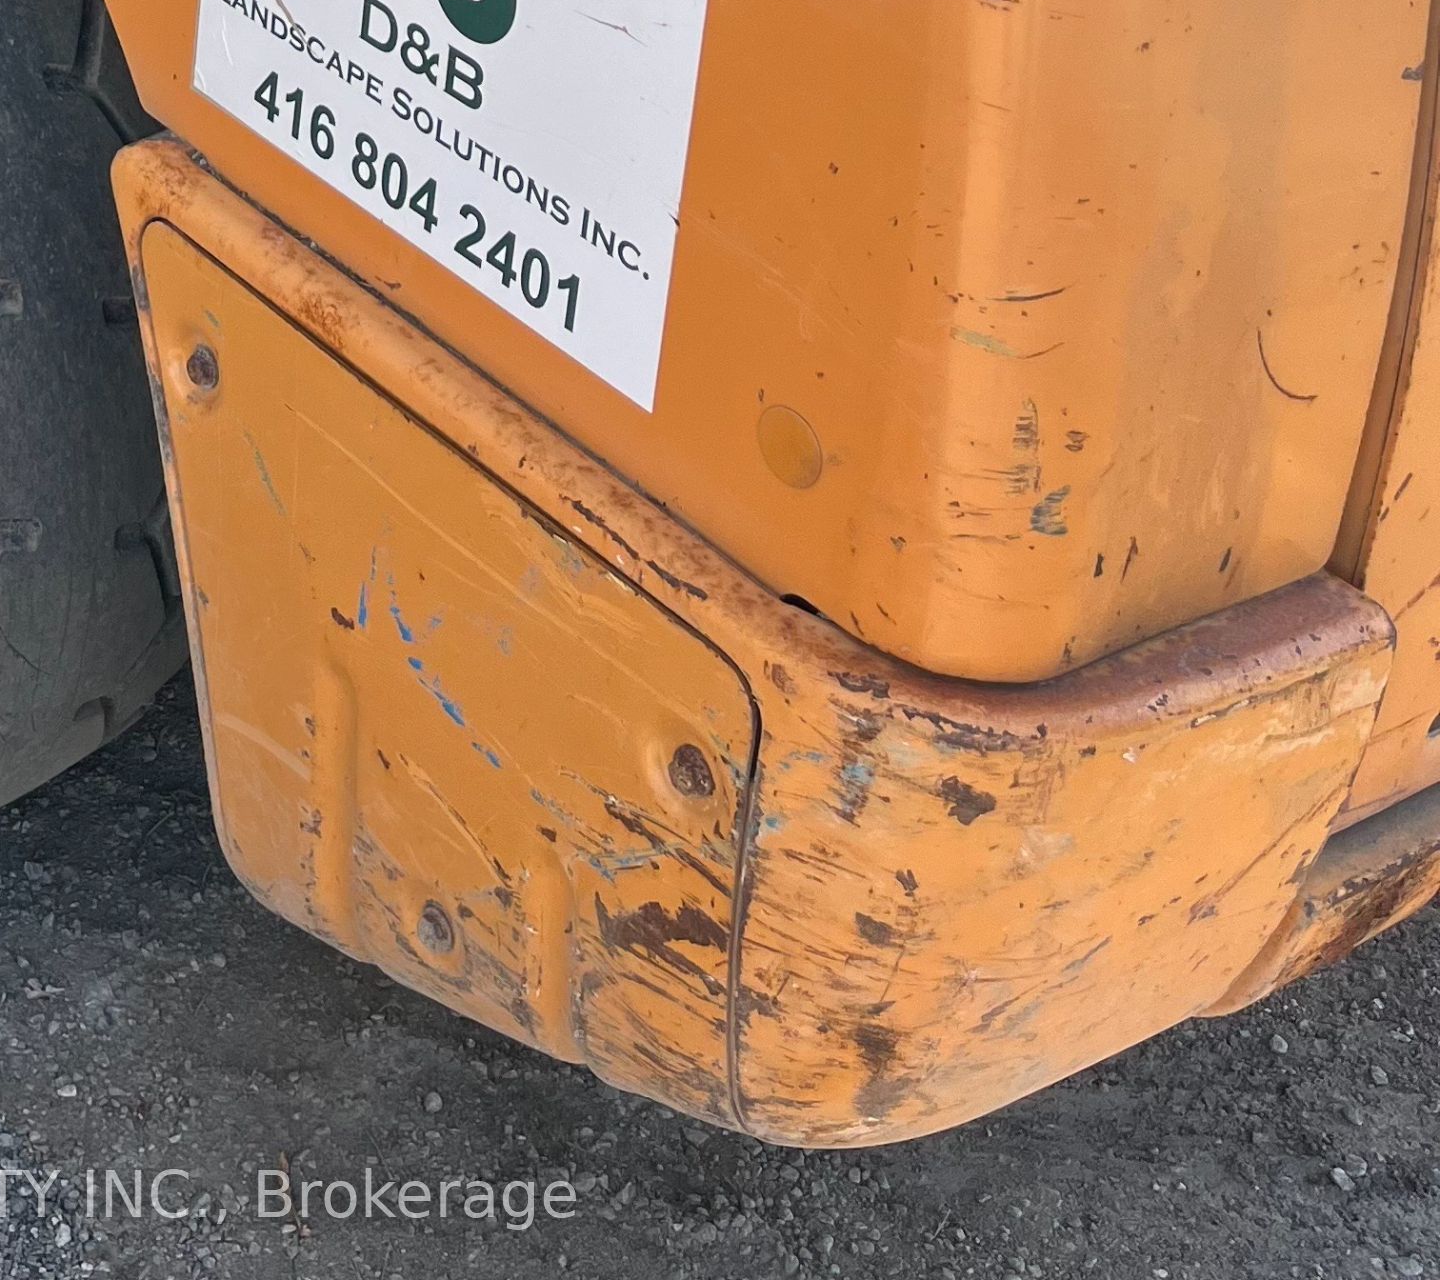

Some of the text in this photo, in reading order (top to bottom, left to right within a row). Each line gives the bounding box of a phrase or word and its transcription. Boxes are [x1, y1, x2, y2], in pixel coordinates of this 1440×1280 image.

[253, 71, 581, 333] 416 804 2401
[391, 87, 570, 226] SOLUTIONS
[580, 206, 650, 281] INC.
